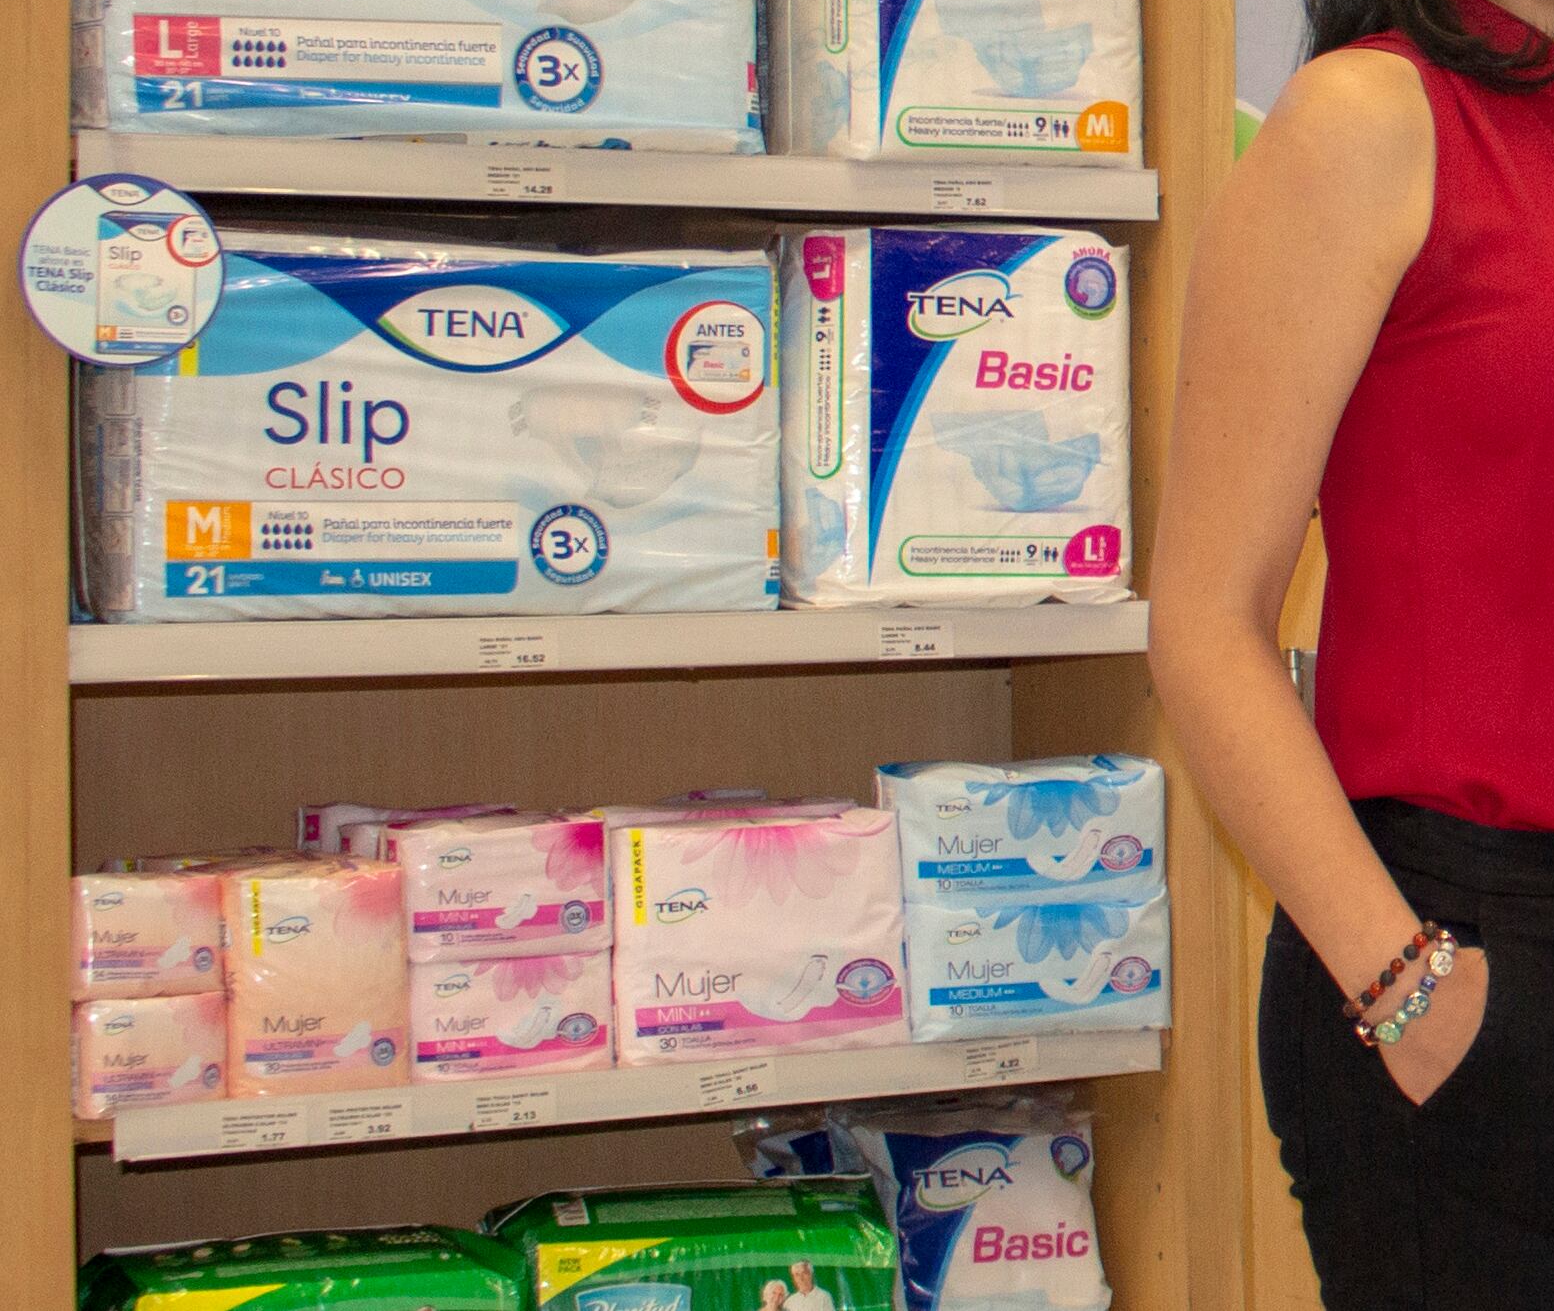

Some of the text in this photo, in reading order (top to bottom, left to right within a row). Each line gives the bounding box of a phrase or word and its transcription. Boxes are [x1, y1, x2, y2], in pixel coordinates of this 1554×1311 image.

[159, 20, 183, 59] L
[297, 35, 497, 53] Pañal para incontinencia fuerte
[537, 55, 579, 87] 3x
[161, 80, 203, 109] 21
[1034, 117, 1047, 133] 9
[109, 246, 143, 261] Slip
[1073, 247, 1111, 261] AHORA
[910, 295, 1014, 318] TENA
[418, 309, 524, 340] TENA
[696, 323, 745, 338] ANTES
[975, 352, 1094, 392] Basic
[265, 381, 410, 463] Slip
[265, 463, 406, 491] CLÁSICO
[186, 506, 221, 544] M
[323, 517, 513, 533] Pañal para incontinencia fuerte
[551, 530, 589, 561] 3x
[1026, 544, 1037, 558] 9
[185, 566, 225, 595] 21
[368, 572, 432, 587] UNISEX
[936, 804, 972, 813] TENA
[938, 836, 1003, 858] Mujer
[438, 853, 472, 864] TENA
[633, 839, 643, 909] GIGAPACK
[937, 863, 991, 874] MEDIUM
[937, 879, 951, 890] 10
[439, 889, 492, 908] Mujer
[656, 898, 708, 915] TENA
[266, 923, 311, 935] TENA
[947, 928, 982, 938] TENA
[948, 961, 1014, 983] Mujer
[434, 980, 471, 992] TENA
[655, 971, 742, 1003] Mujer
[949, 988, 1001, 1000] MEDIUM
[656, 1007, 697, 1023] MINI
[950, 1005, 963, 1016] 10
[263, 1015, 326, 1036] Mujer
[436, 1015, 489, 1035] Mujer
[659, 1037, 677, 1051] 30
[918, 1169, 1014, 1189] TENA
[974, 1223, 1090, 1263] Basic
